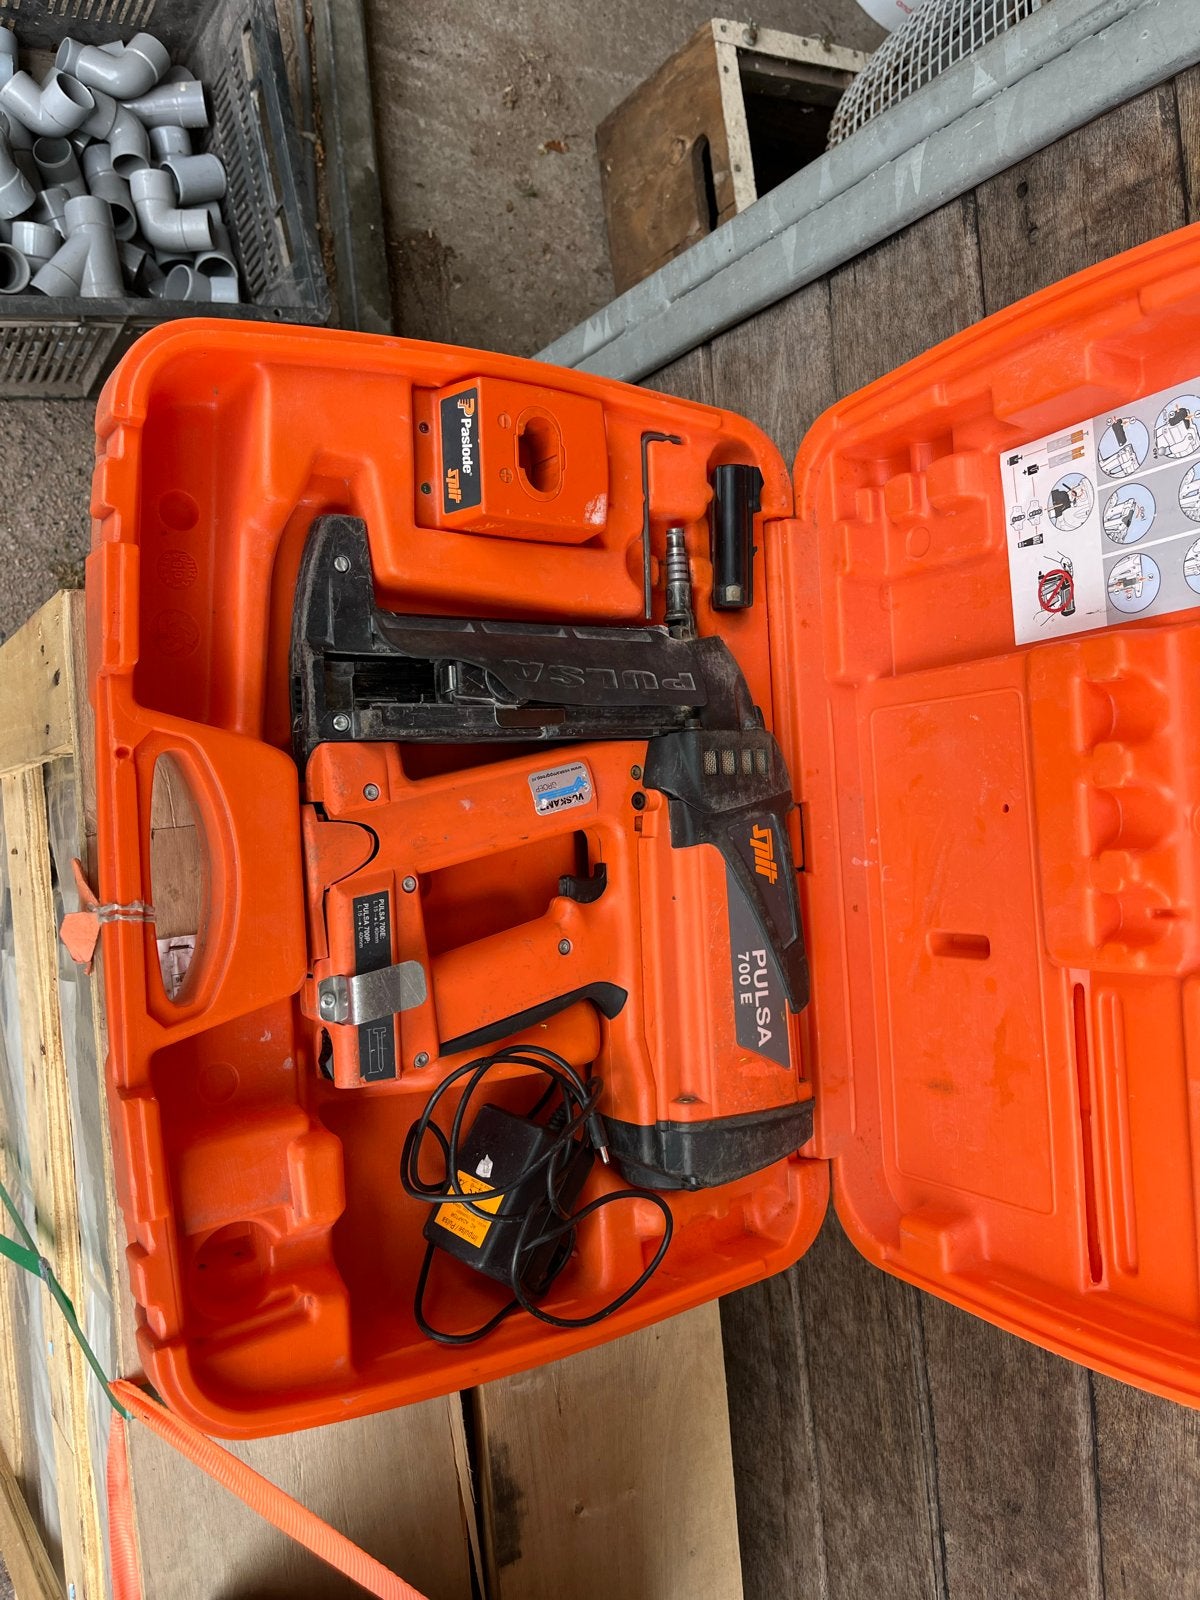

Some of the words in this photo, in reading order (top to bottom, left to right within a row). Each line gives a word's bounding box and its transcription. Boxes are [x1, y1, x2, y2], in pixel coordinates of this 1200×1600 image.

[460, 418, 473, 474] Paslode
[502, 659, 697, 691] PULSA
[362, 904, 370, 925] PULSA
[737, 951, 751, 985] 700
[740, 992, 752, 1005] E
[751, 949, 772, 1047] PULSA
